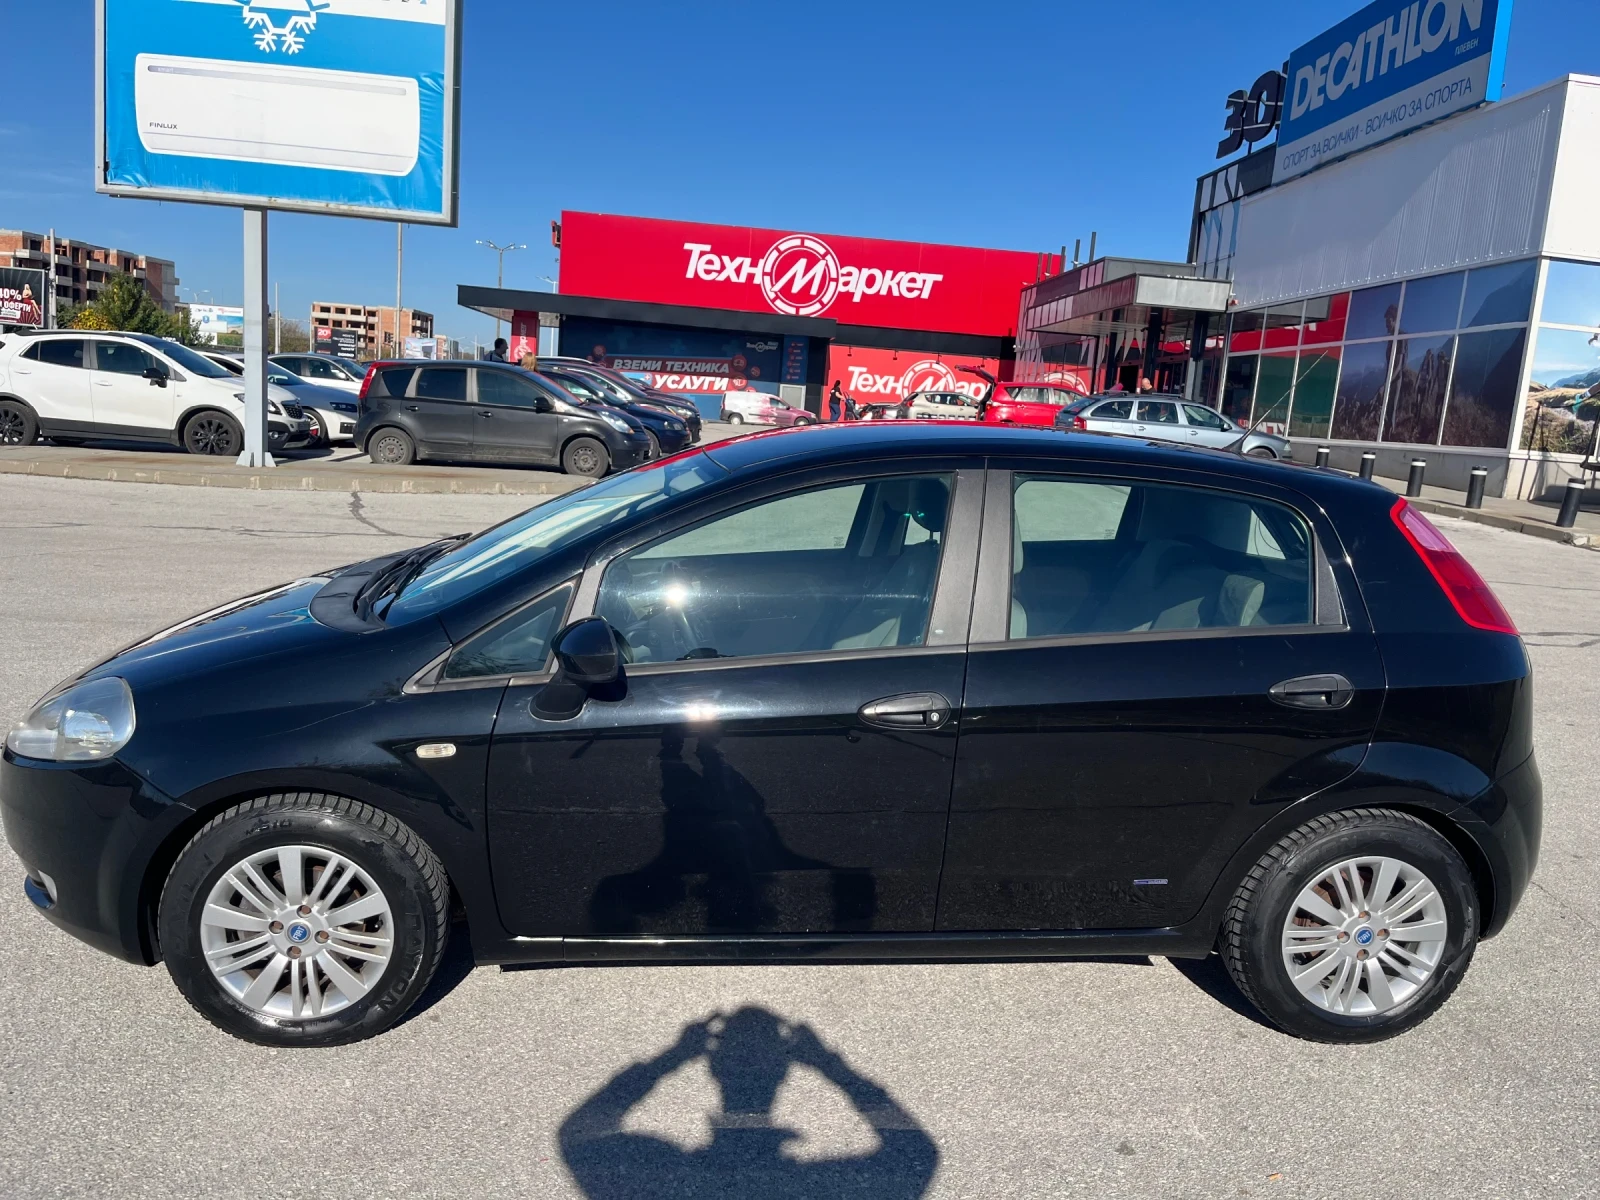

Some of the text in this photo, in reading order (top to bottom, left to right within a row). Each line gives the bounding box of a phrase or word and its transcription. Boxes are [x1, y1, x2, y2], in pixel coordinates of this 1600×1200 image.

[1290, 0, 1484, 122] DECATHLON
[149, 121, 178, 130] FINLUX
[1283, 147, 1310, 171] СПОРТ
[1322, 124, 1360, 153] ВСИЧКИ
[1365, 106, 1407, 135] ВСИЧКО
[1408, 100, 1422, 118] ЗА
[1424, 76, 1472, 110] СПОРТА
[613, 359, 730, 374] ВЗЕМИ ТЕХНИКА
[654, 374, 729, 391] УСЛУГИ
[292, 925, 305, 940] FIAT
[1358, 931, 1371, 943] FIAT
